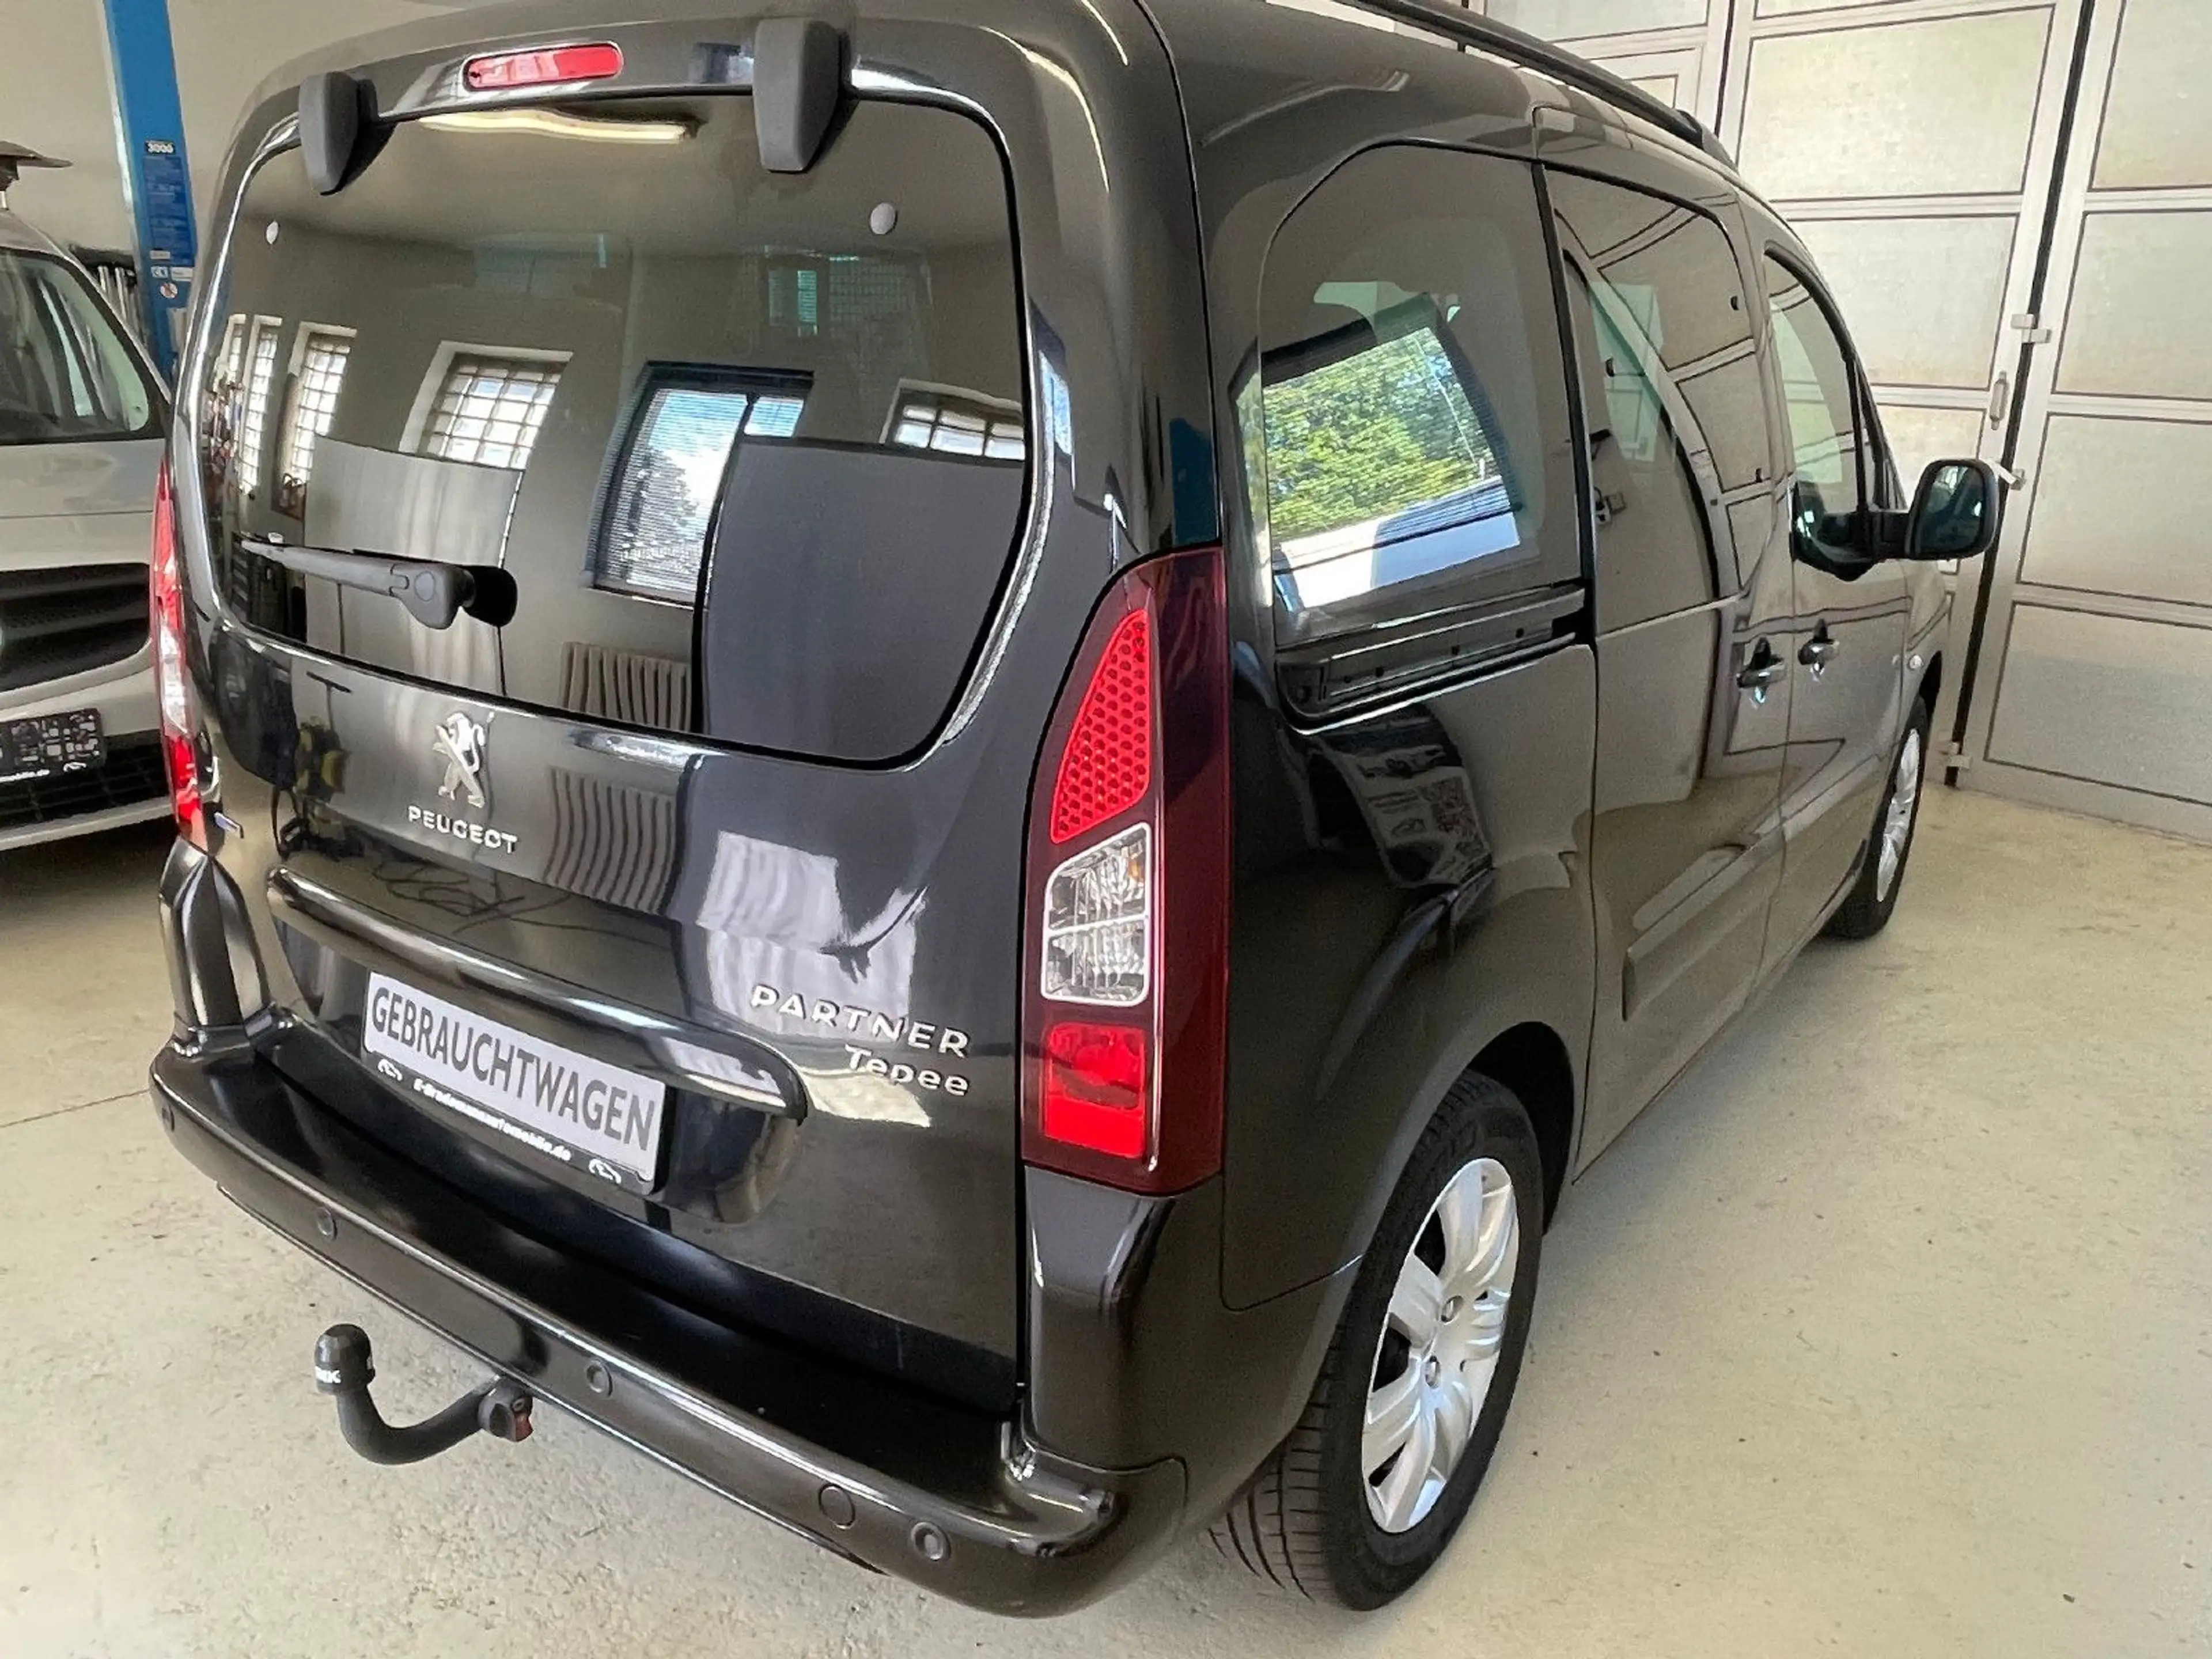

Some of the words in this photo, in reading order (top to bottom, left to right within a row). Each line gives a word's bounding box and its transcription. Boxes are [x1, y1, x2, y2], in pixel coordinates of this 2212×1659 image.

[408, 805, 518, 854] PEUGEOT
[750, 984, 969, 1058] PARTNER
[372, 987, 654, 1151] GEBRAUCHTWAGEN
